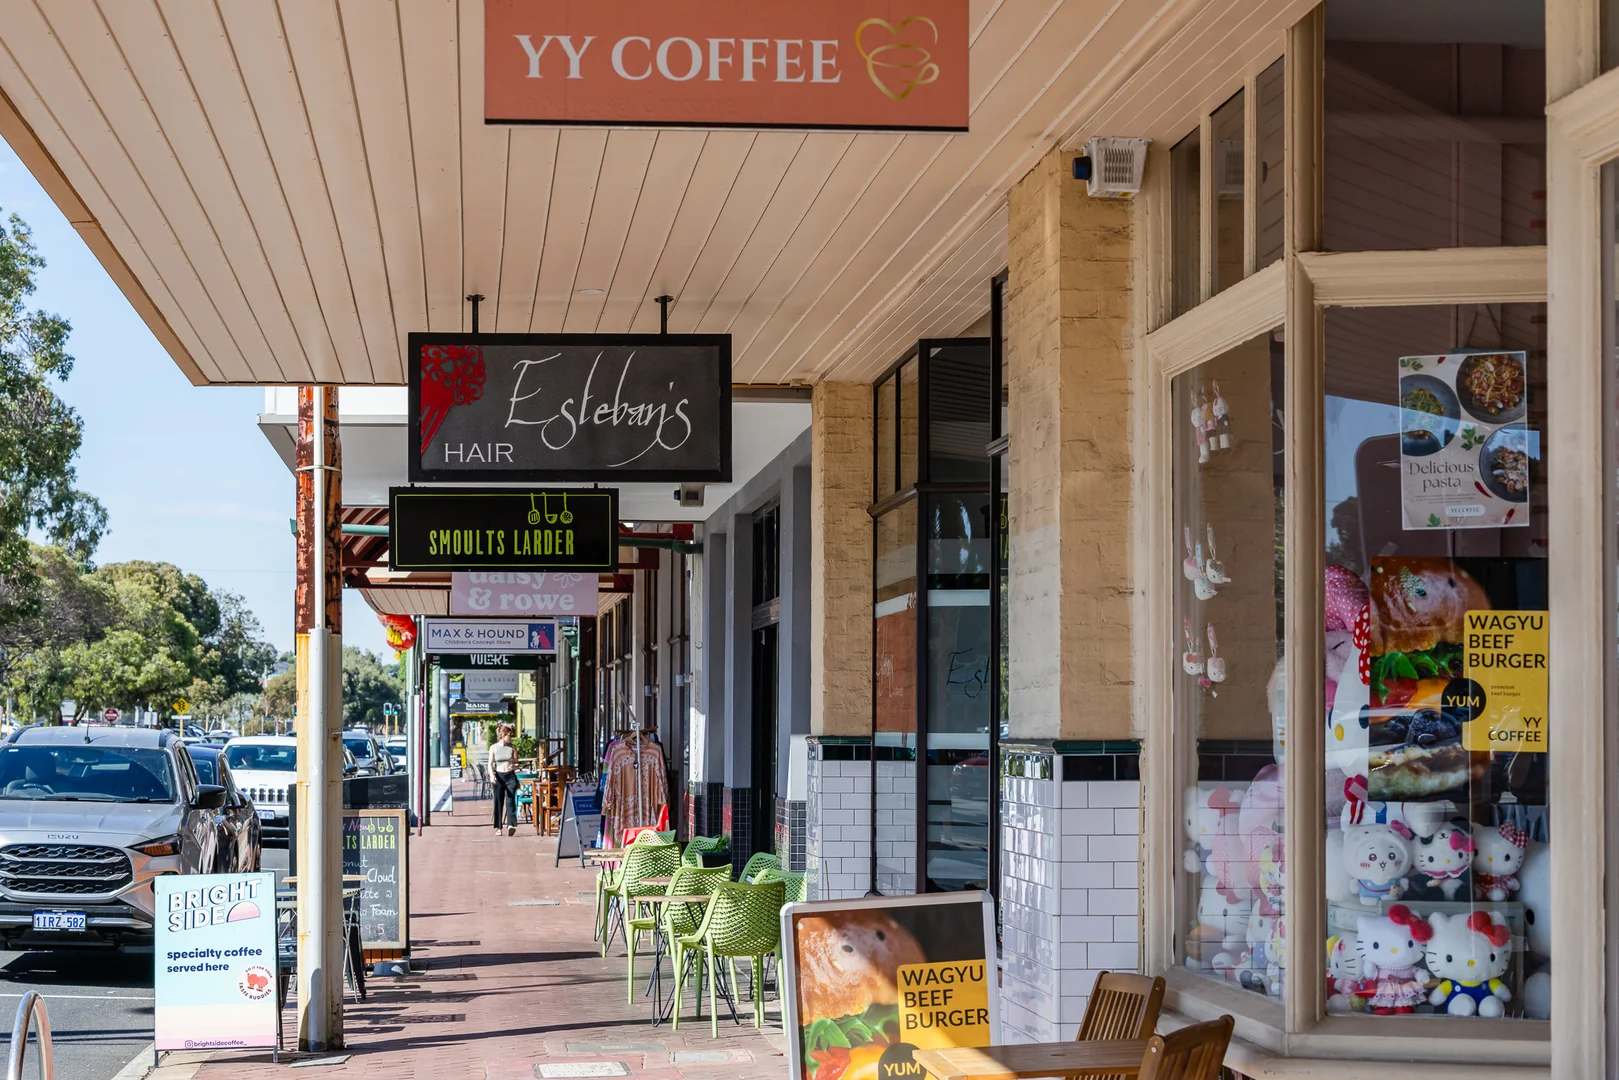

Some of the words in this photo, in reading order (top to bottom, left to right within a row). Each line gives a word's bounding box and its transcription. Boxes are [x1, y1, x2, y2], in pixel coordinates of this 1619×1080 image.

[512, 35, 598, 79] YY
[611, 36, 842, 84] COFFEE
[504, 350, 692, 467] Esteban's
[444, 443, 514, 462] HAIR
[1409, 460, 1474, 475] Delicious
[1422, 478, 1462, 492] pasta
[430, 530, 505, 555] SMOULTS
[514, 530, 574, 555] LARDER
[468, 587, 492, 610] &
[499, 593, 575, 610] rowe
[1469, 616, 1543, 630] WAGYU
[432, 629, 460, 638] MAX
[464, 628, 474, 638] &
[478, 630, 525, 638] HOUND
[1469, 634, 1514, 648] BEEF
[1469, 653, 1546, 668] BURGER
[1446, 696, 1479, 707] YUM
[1524, 717, 1541, 728] YY
[1488, 730, 1541, 742] COFFEE
[362, 834, 395, 849] LARDER
[367, 866, 396, 884] Cloud
[168, 878, 262, 912] BRIGHT
[370, 904, 398, 917] Foam
[168, 905, 225, 932] SIDE
[167, 948, 222, 960] specialty
[224, 947, 262, 957] coffee
[167, 963, 203, 973] served
[205, 962, 229, 972] here
[902, 965, 983, 986] WAGYU
[904, 989, 953, 1008] BEEF
[906, 1008, 989, 1030] BURGER
[884, 1062, 920, 1076] YUM
